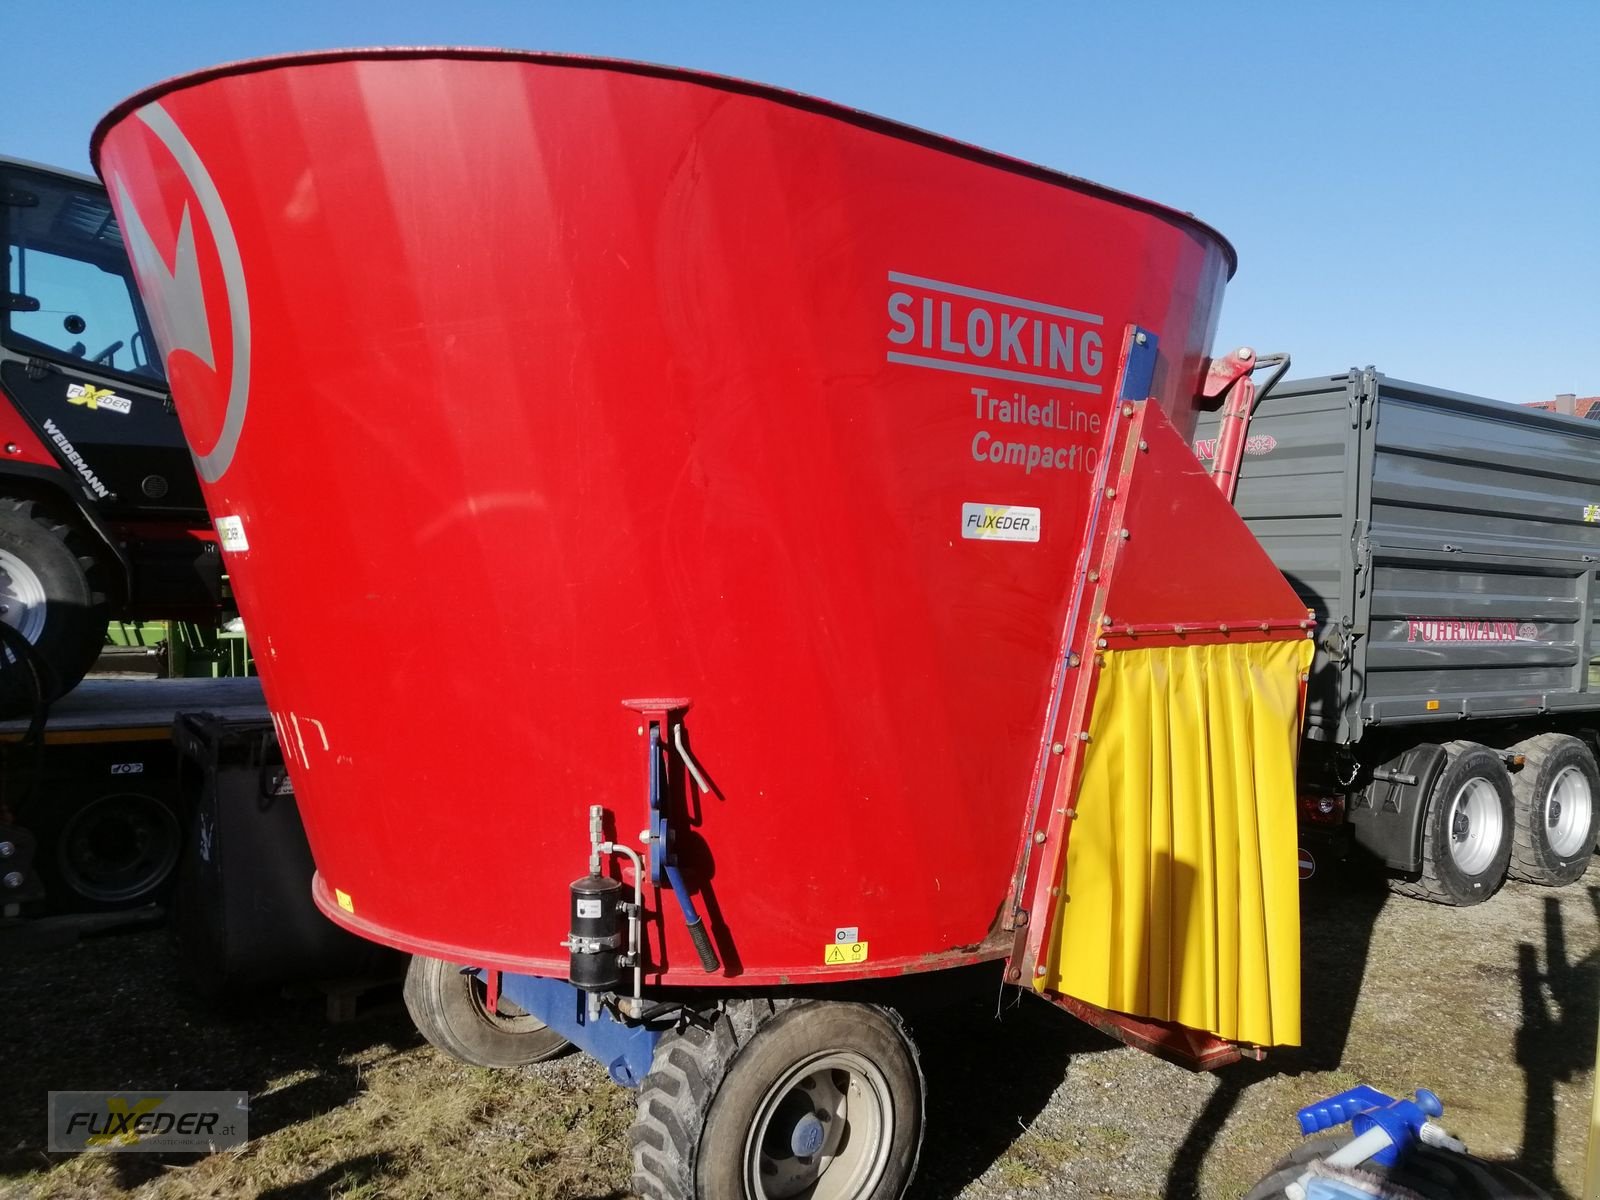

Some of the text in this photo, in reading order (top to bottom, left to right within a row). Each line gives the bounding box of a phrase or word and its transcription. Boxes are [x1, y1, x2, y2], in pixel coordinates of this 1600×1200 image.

[887, 291, 1103, 377] SILOKING
[69, 387, 130, 409] FLIXEDER
[971, 387, 1101, 433] TrailedLine
[43, 418, 109, 498] WEIDEMANN
[1407, 617, 1518, 643] FUHRMANN
